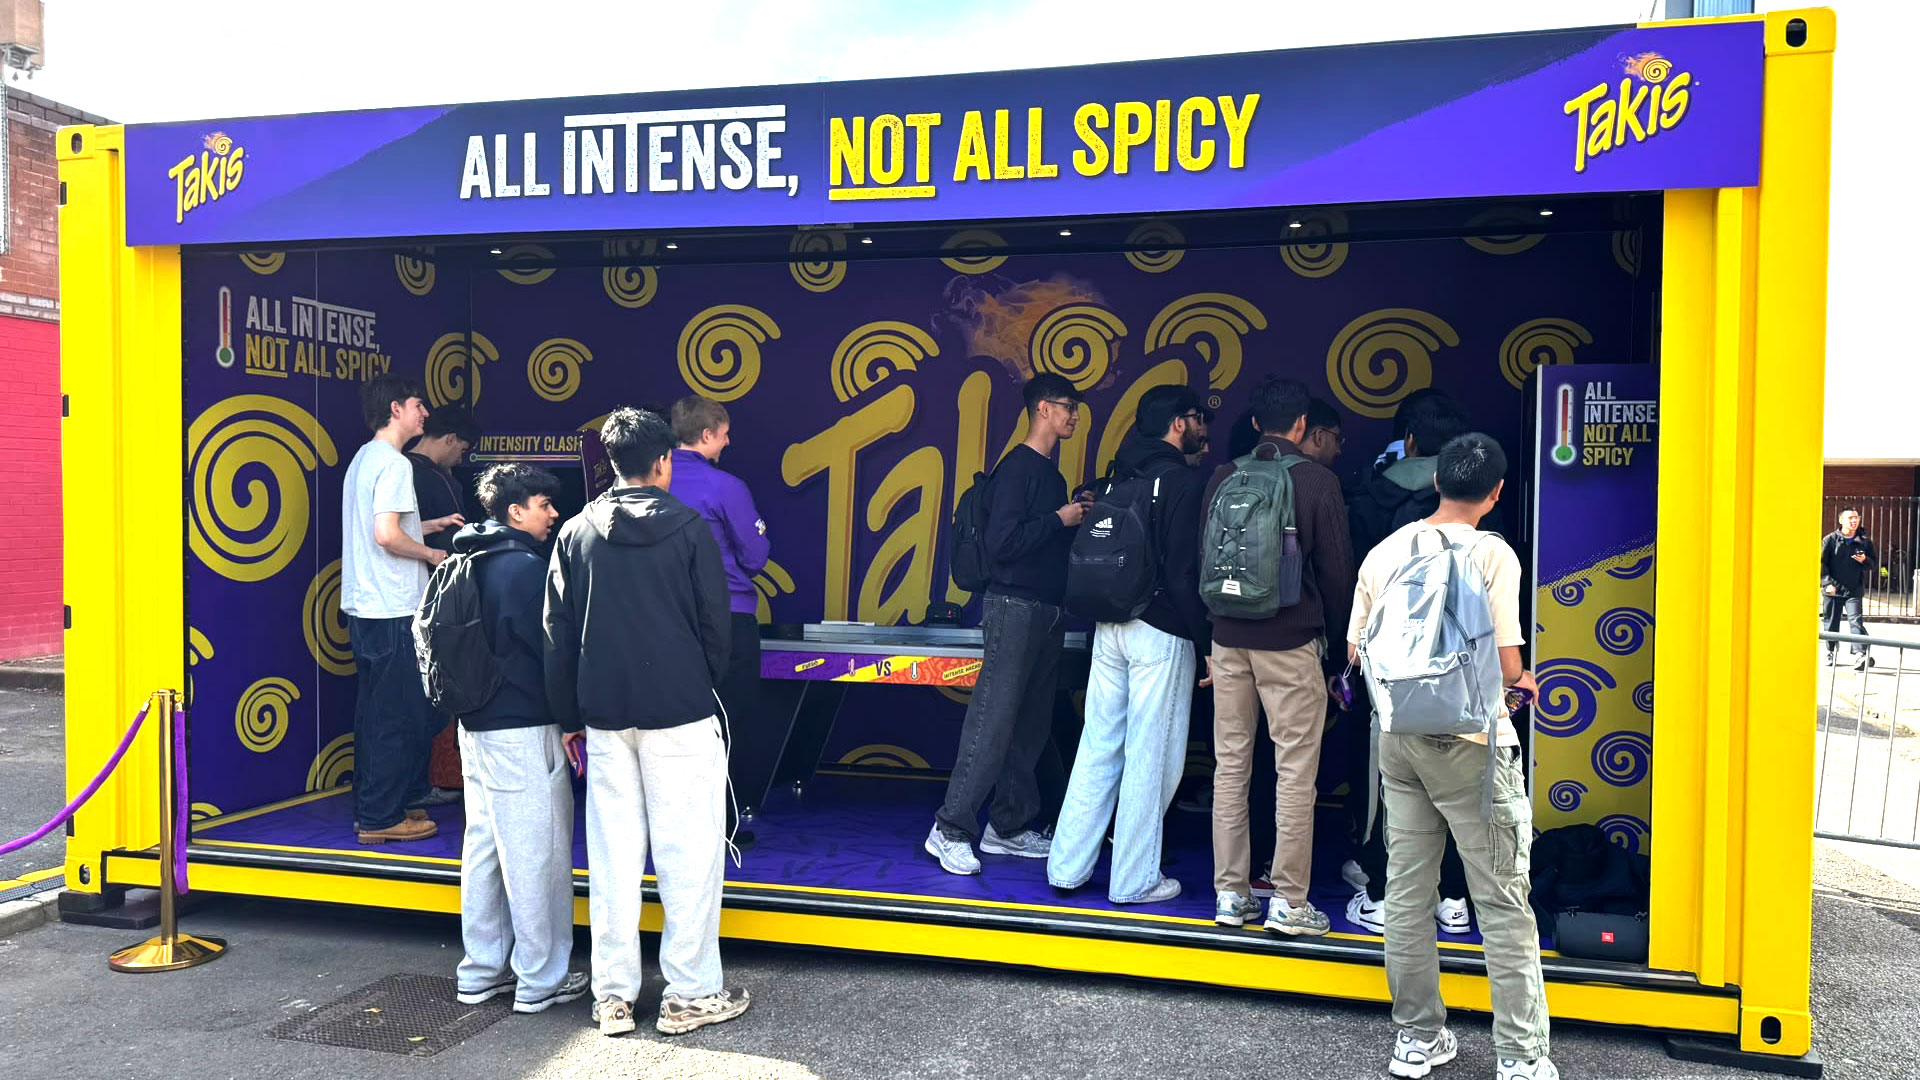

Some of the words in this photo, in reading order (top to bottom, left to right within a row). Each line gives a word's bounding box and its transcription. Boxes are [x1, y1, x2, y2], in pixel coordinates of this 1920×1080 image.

[1563, 59, 1692, 172] Takis
[459, 132, 550, 199] ALL
[563, 104, 799, 197] INTENSE,
[828, 112, 942, 187] NOT
[953, 106, 1059, 182] ALL
[1072, 93, 1261, 178] SPICY
[168, 136, 244, 224] Takis
[246, 295, 288, 334] ALL
[291, 296, 381, 354] INTENSE,
[245, 332, 290, 372] NOT
[293, 340, 332, 378] ALL
[335, 347, 392, 382] SPICY
[1584, 381, 1617, 400] ALL
[479, 435, 540, 452] INTENSITY
[1583, 423, 1618, 443] NOT
[1620, 423, 1652, 443] ALL
[1582, 446, 1634, 466] SPICY
[875, 660, 892, 677] VS
